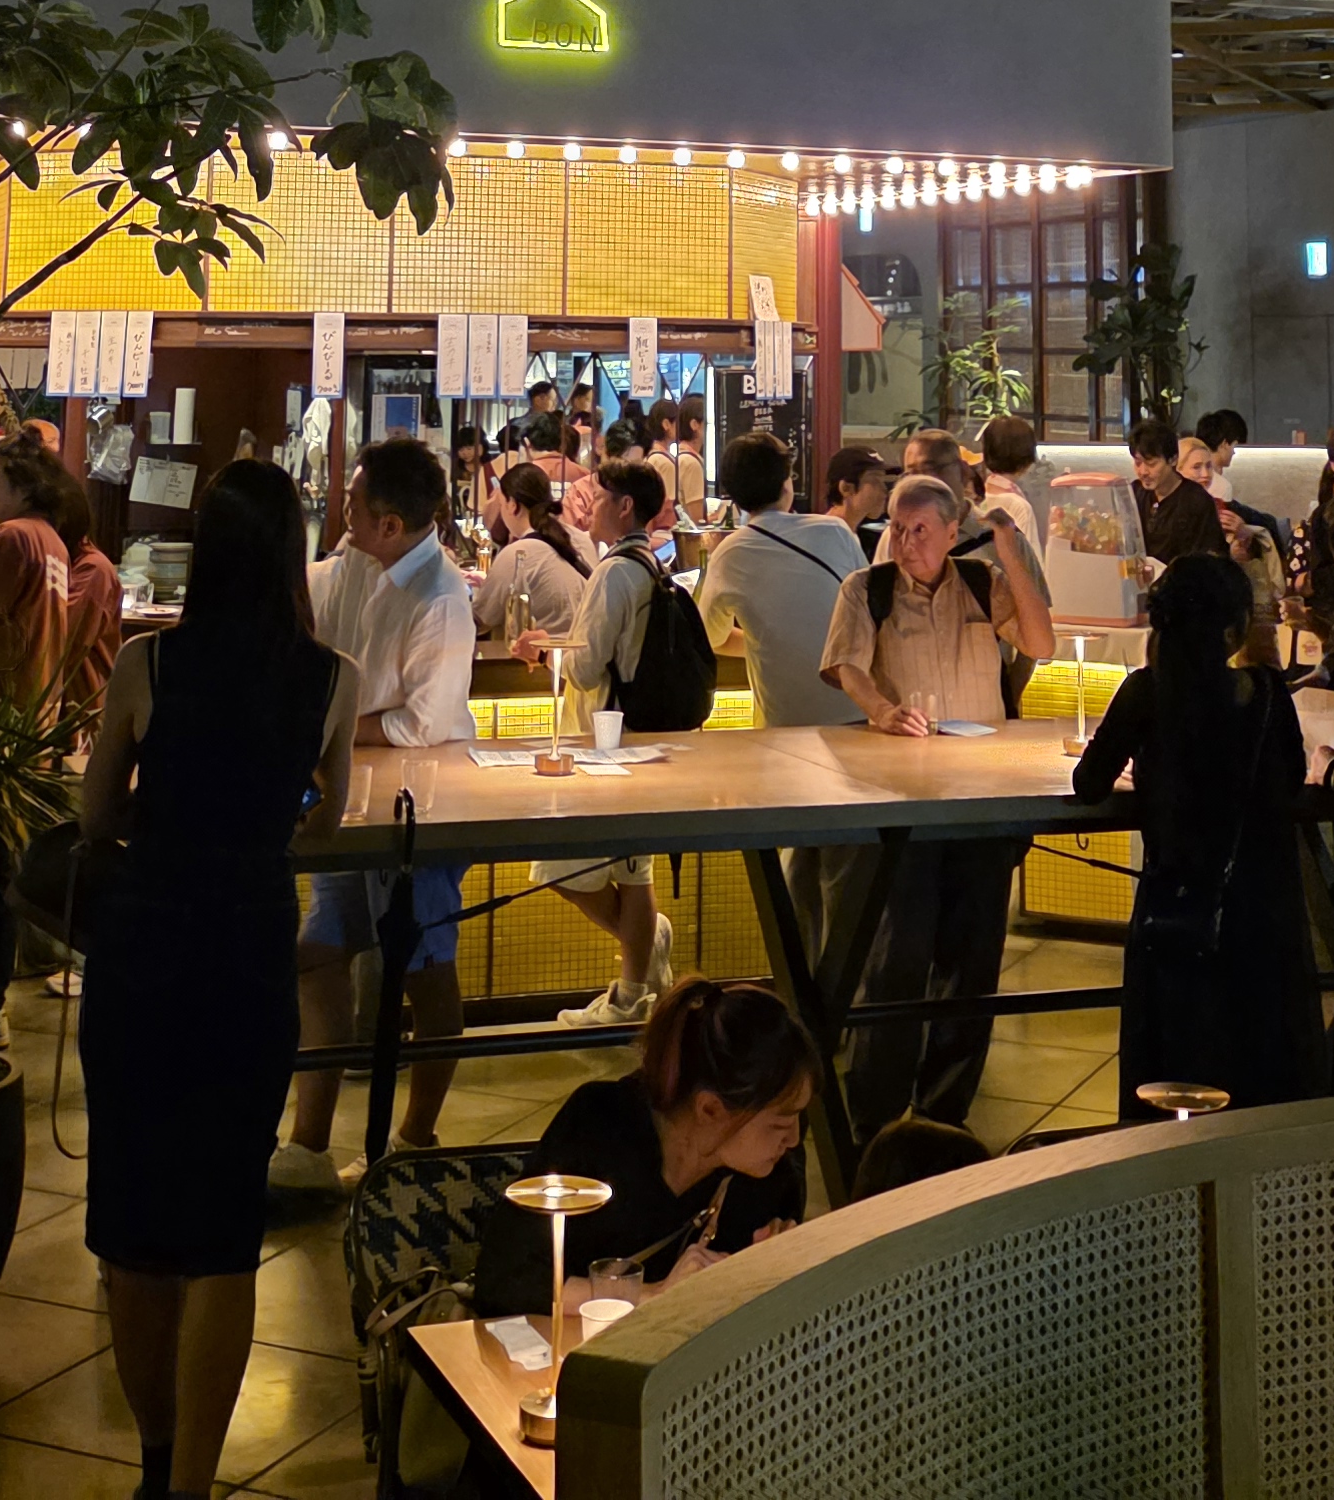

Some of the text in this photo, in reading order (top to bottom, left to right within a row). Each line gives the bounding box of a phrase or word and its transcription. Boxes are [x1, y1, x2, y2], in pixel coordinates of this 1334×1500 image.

[532, 18, 598, 53] BON
[132, 331, 145, 377] びんビール
[322, 331, 337, 380] びんびーる
[635, 336, 649, 371] 瓶ビール
